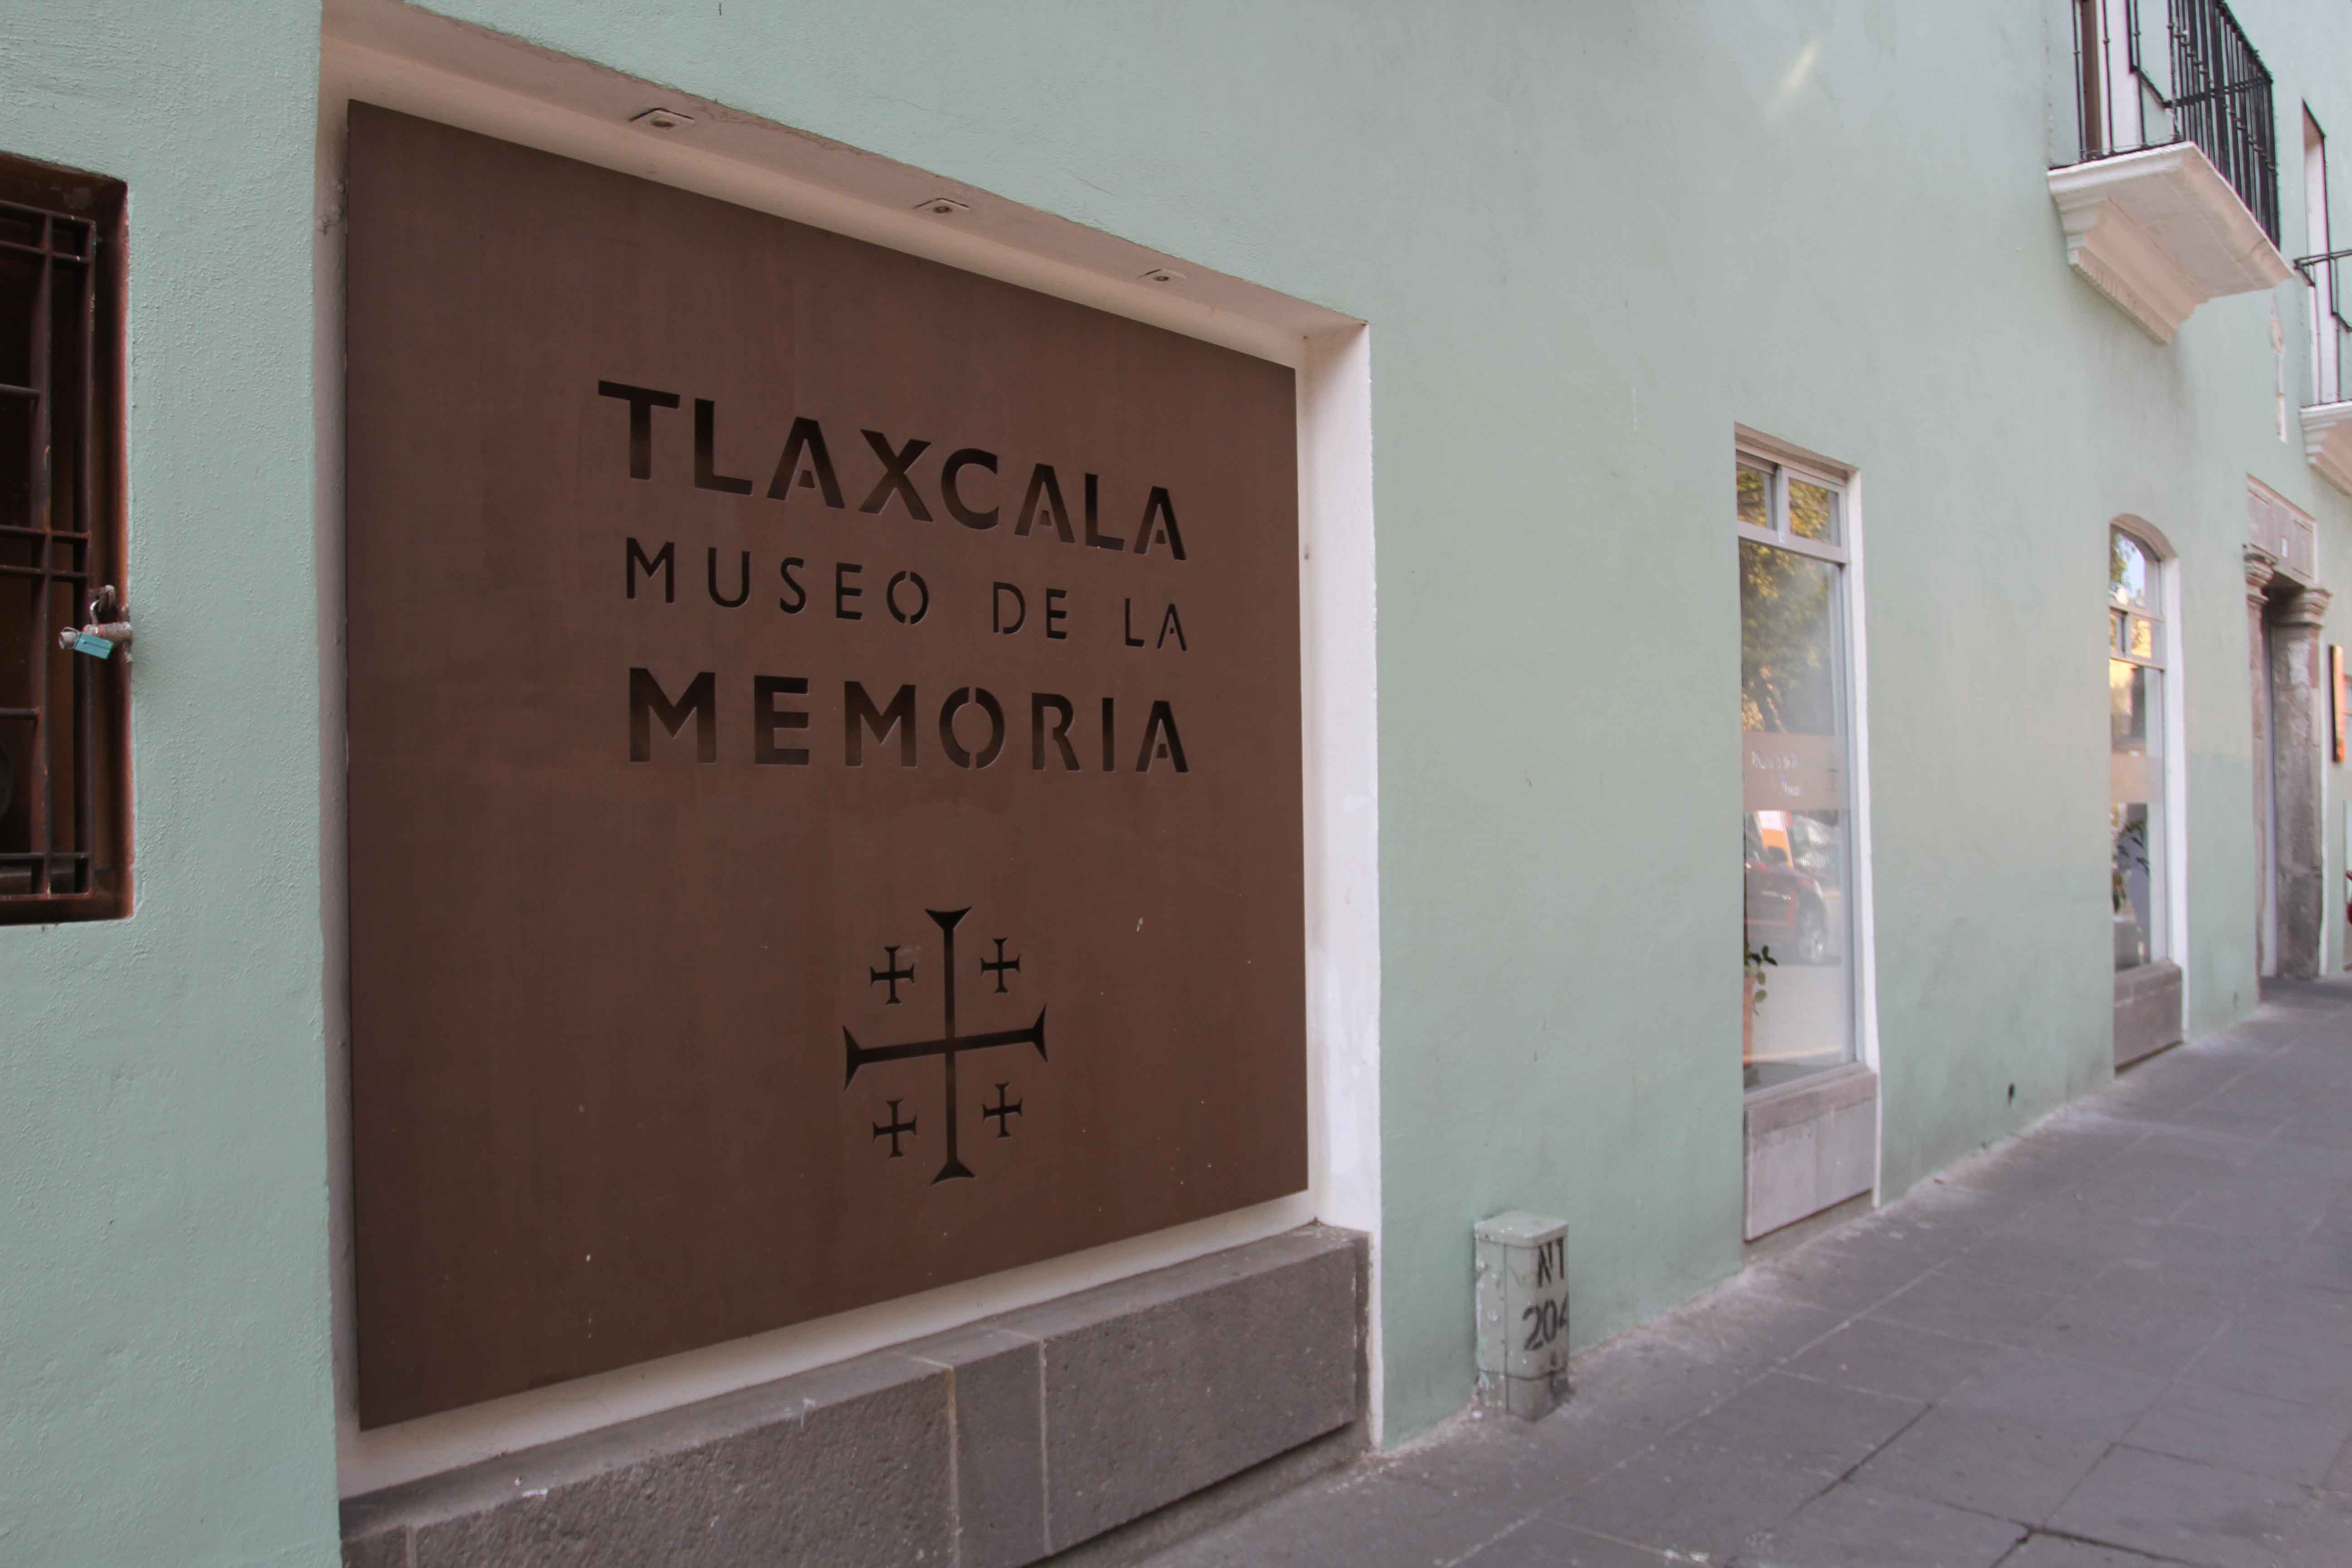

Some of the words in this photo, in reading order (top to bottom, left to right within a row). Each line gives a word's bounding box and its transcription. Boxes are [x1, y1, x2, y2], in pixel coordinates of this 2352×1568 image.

[598, 379, 1187, 561] TLAXCALA
[626, 537, 930, 625] MUSEO
[993, 581, 1068, 640] DE
[1124, 598, 1188, 652] LA
[629, 666, 1189, 774] MEMORIA
